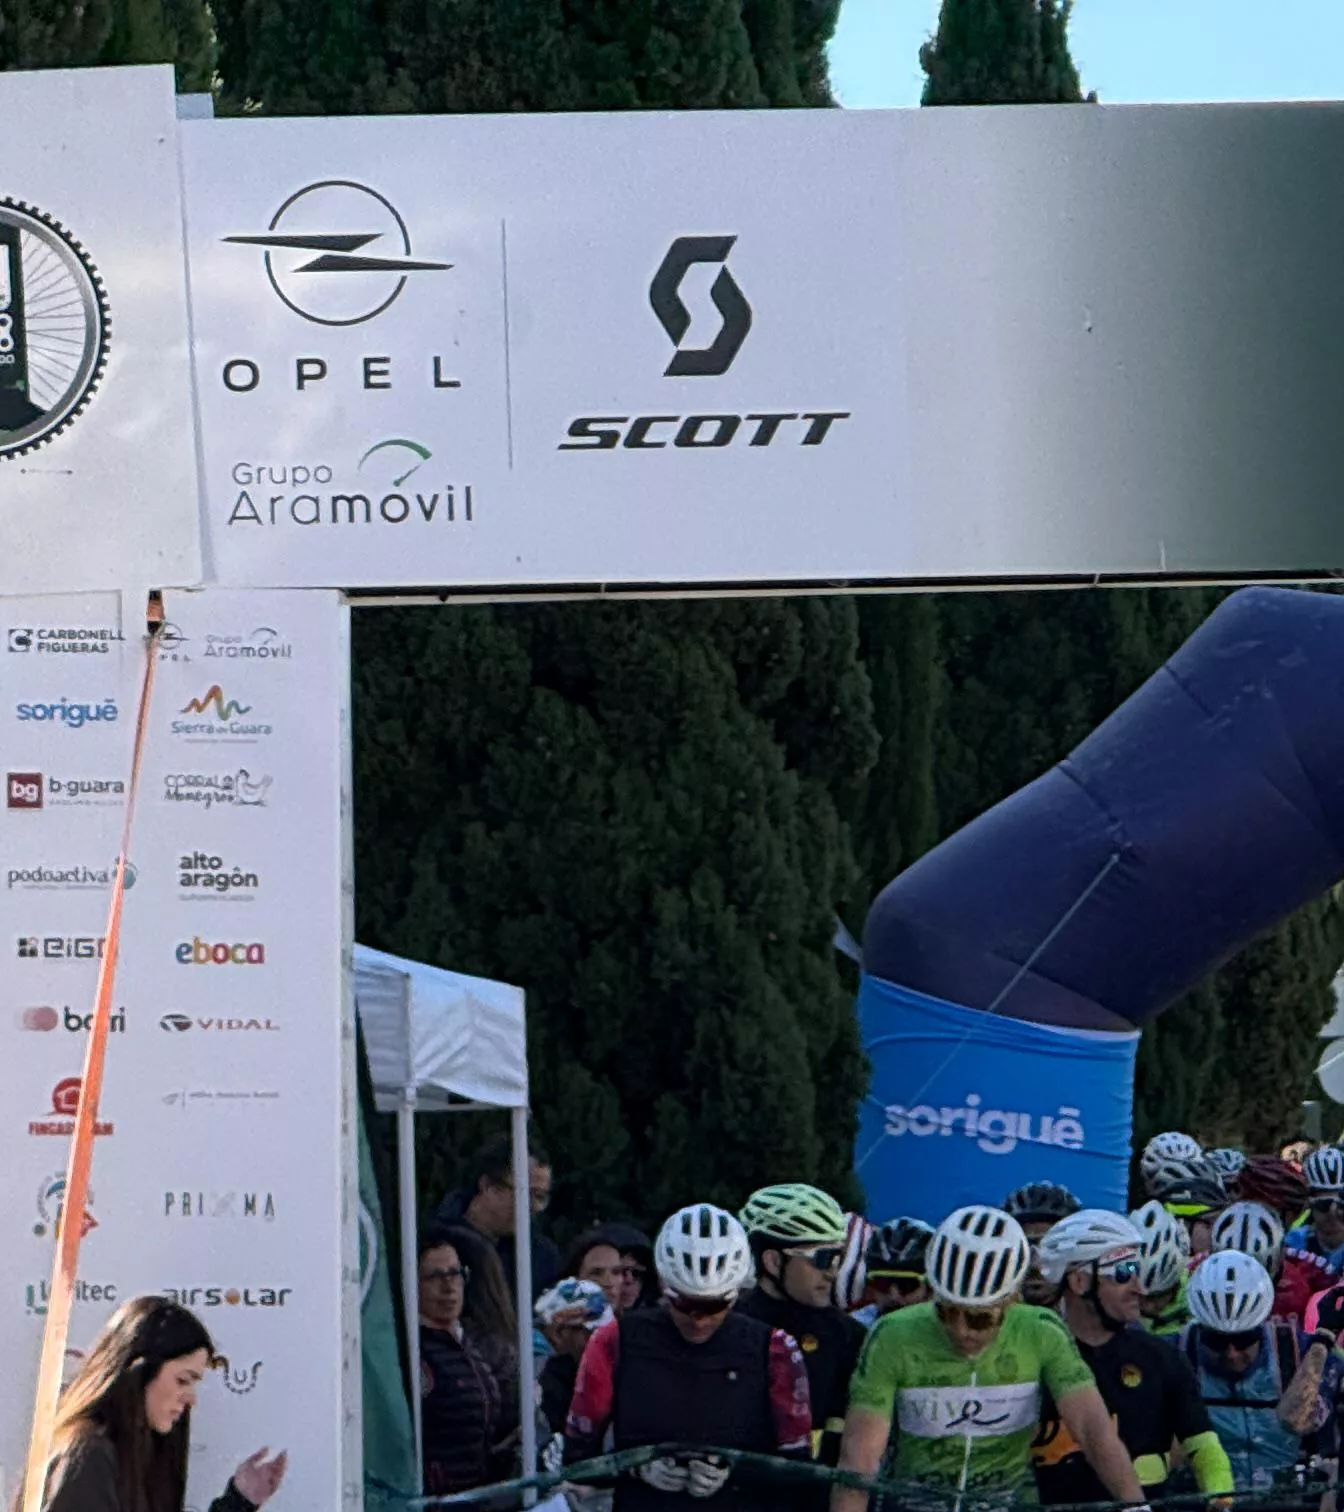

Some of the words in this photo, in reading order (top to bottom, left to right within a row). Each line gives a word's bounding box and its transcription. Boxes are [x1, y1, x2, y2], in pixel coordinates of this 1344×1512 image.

[222, 356, 462, 392] OPEL
[557, 412, 850, 451] SCOTT
[231, 462, 333, 487] Grupo
[37, 628, 126, 642] CARBONELL
[37, 641, 109, 654] FIGUERAS
[171, 721, 215, 734] Sierra
[230, 721, 273, 735] Guara
[11, 780, 39, 803] bg
[179, 851, 223, 871] alto
[7, 866, 110, 889] podoactiva
[175, 937, 265, 965] eboca
[198, 1018, 281, 1030] VIDAL
